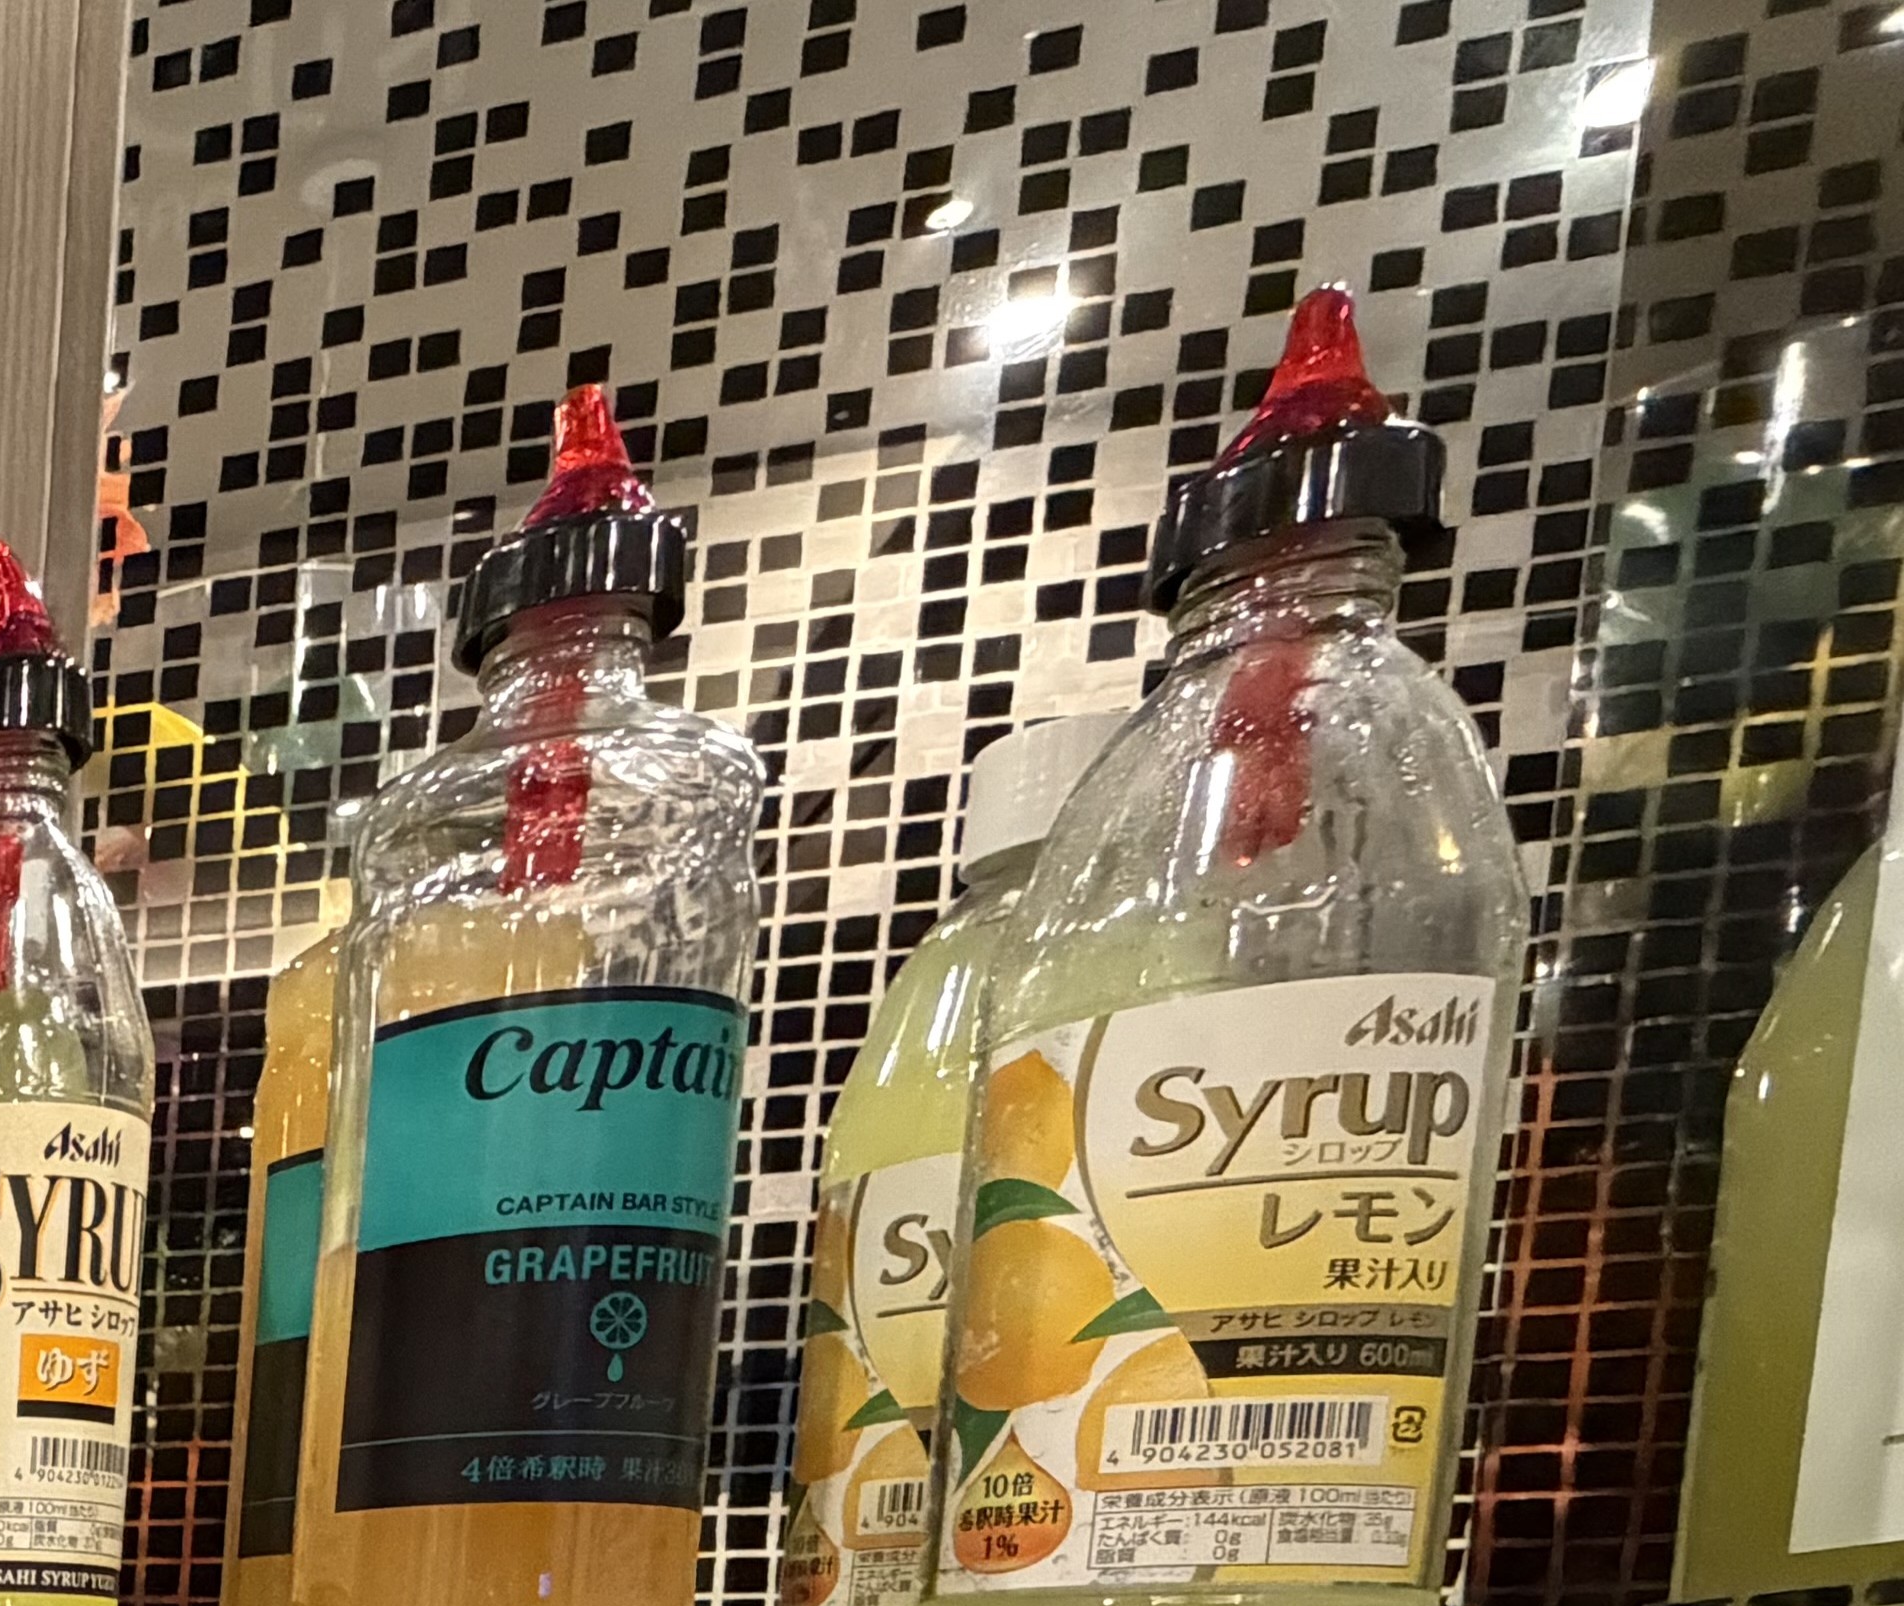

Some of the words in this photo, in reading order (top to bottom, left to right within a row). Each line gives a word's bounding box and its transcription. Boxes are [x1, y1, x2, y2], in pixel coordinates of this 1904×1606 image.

[1344, 993, 1480, 1047] Asahi
[1129, 1065, 1470, 1177] Syrup
[44, 1121, 122, 1168] Asahi
[1282, 1138, 1403, 1166] シロップ
[496, 1191, 614, 1216] CAPTAIN
[621, 1191, 668, 1212] BAR
[671, 1195, 720, 1221] STYLE
[1259, 1186, 1456, 1249] レモン
[484, 1243, 716, 1289] GRAPEFRUIT
[1323, 1256, 1448, 1291] 果汁入り
[12, 1300, 82, 1328] アサヒ
[1210, 1312, 1283, 1333] アサヒ
[1294, 1309, 1380, 1328] シロップ
[1235, 1343, 1347, 1369] 果汁入り
[36, 1345, 111, 1397] ゆず
[1106, 1450, 1119, 1466] 4
[1142, 1442, 1248, 1464] 904230
[1260, 1441, 1356, 1460] 052081
[983, 1471, 1034, 1498] 10倍
[884, 1513, 919, 1528] 904
[983, 1534, 1019, 1560] 1%
[42, 1569, 91, 1588] SYRUP
